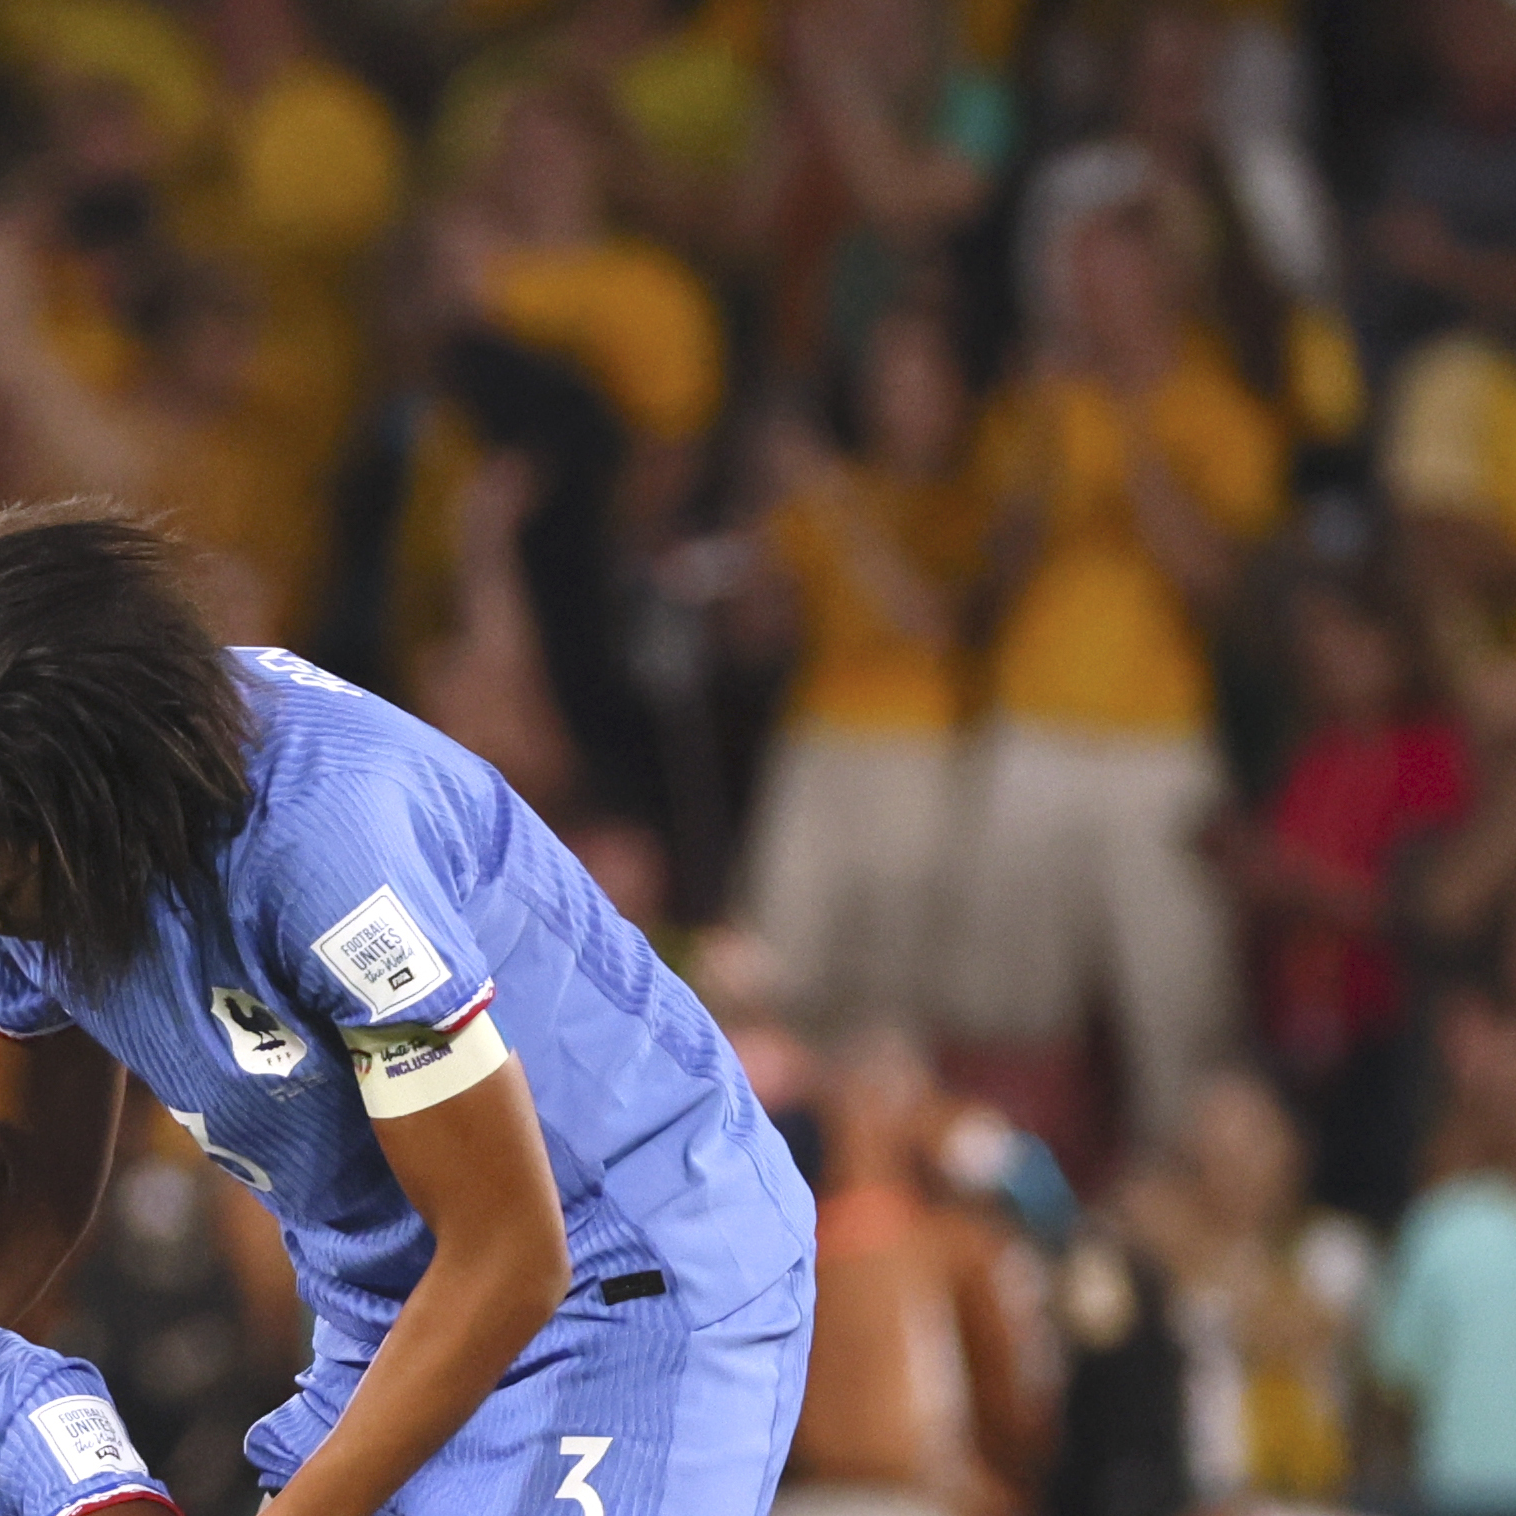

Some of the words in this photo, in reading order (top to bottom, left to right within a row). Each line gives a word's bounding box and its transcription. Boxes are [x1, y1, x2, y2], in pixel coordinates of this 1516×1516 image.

[340, 916, 389, 957] FOOTBALL
[350, 927, 402, 971] UNITES
[364, 967, 386, 984] the
[385, 1042, 454, 1079] INCLUSION
